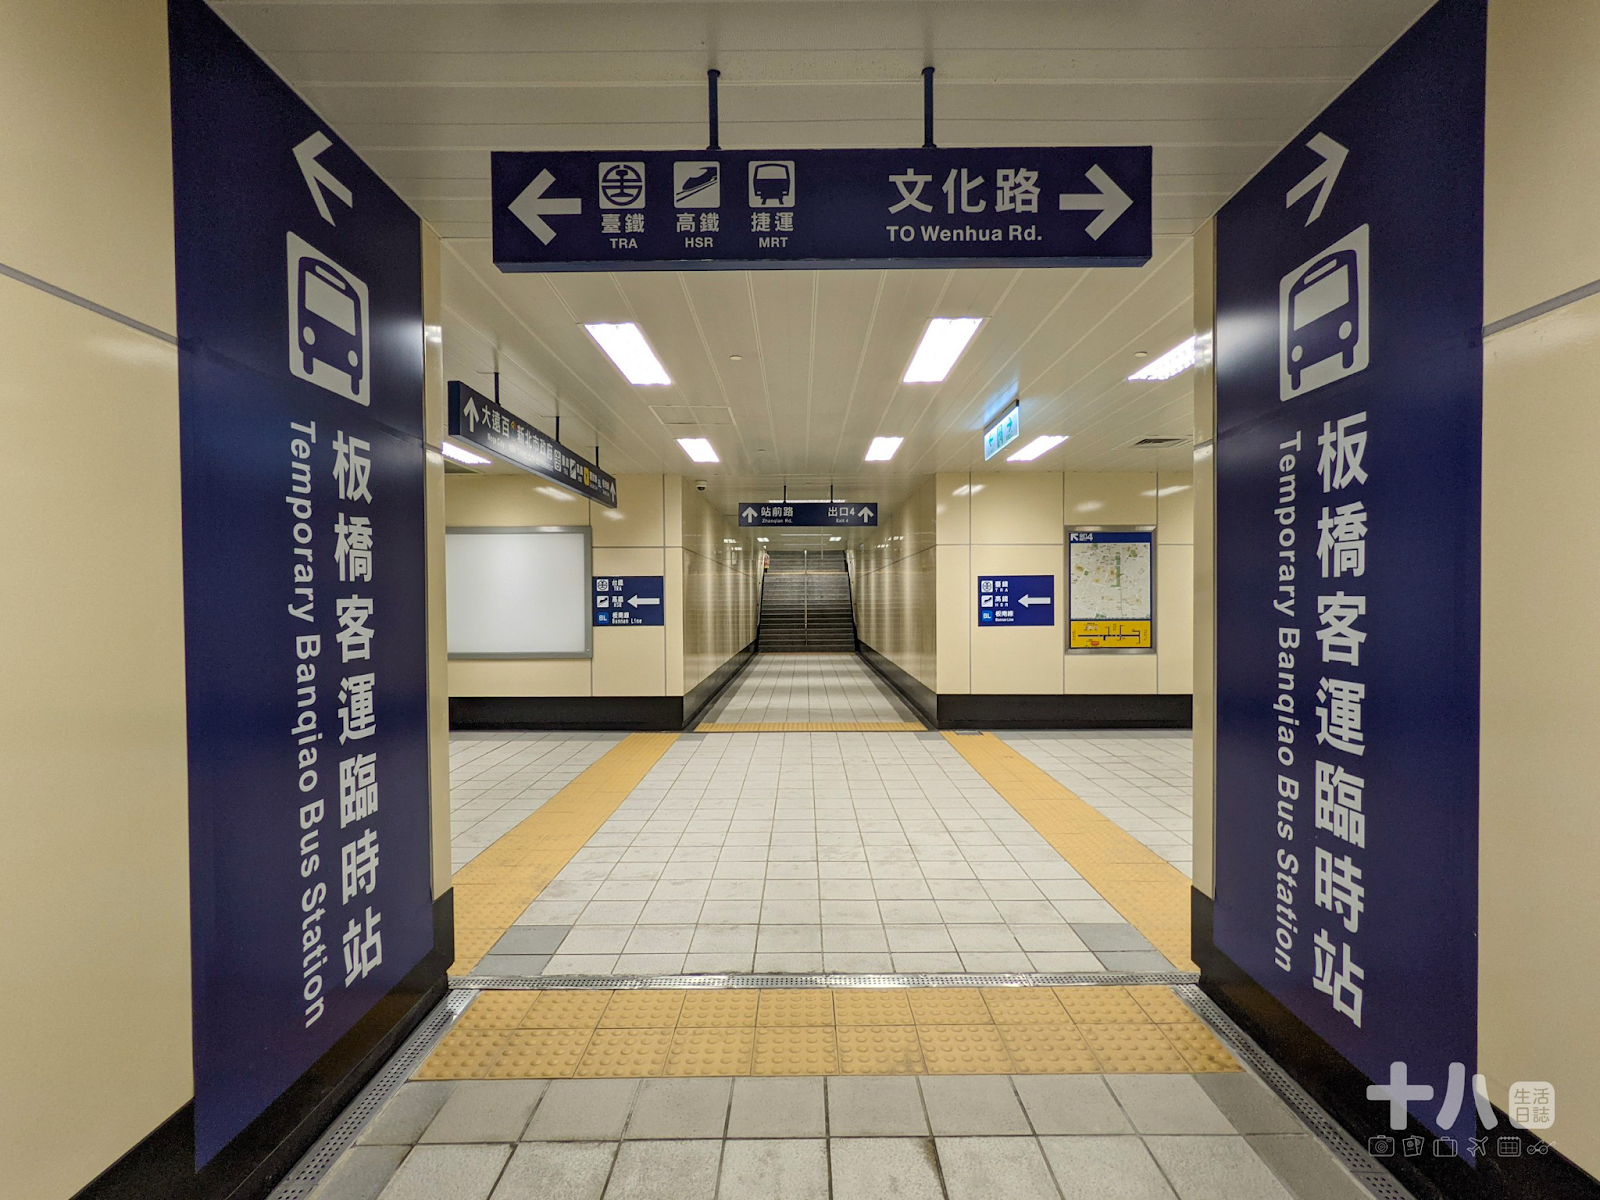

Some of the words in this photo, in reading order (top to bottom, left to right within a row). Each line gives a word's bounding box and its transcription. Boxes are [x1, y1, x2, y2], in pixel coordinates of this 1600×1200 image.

[888, 168, 1040, 214] 文化路
[602, 213, 644, 233] 臺鐵
[610, 237, 638, 248] TRA
[677, 213, 719, 233] 高鐵
[685, 237, 714, 248] HSR
[751, 212, 794, 232] 捷運
[758, 237, 788, 247] MRT
[886, 226, 914, 241] TO
[920, 225, 1003, 241] Wenhua
[1008, 224, 1043, 241] Rd.
[481, 405, 510, 438] 大遠百
[286, 421, 316, 622] Temporary
[761, 506, 793, 517] 站前路
[828, 506, 855, 517] 出口4
[1274, 430, 1301, 617] Temporary
[291, 635, 322, 792] Banqiao
[332, 430, 383, 987] 板橋客運臨時站
[1273, 628, 1300, 766] Banqiao
[1313, 411, 1368, 1028] 板橋客運臨時站
[1277, 774, 1299, 841] Bus
[300, 799, 325, 877] Bus
[1275, 849, 1299, 972] Station
[302, 883, 327, 1028] Station
